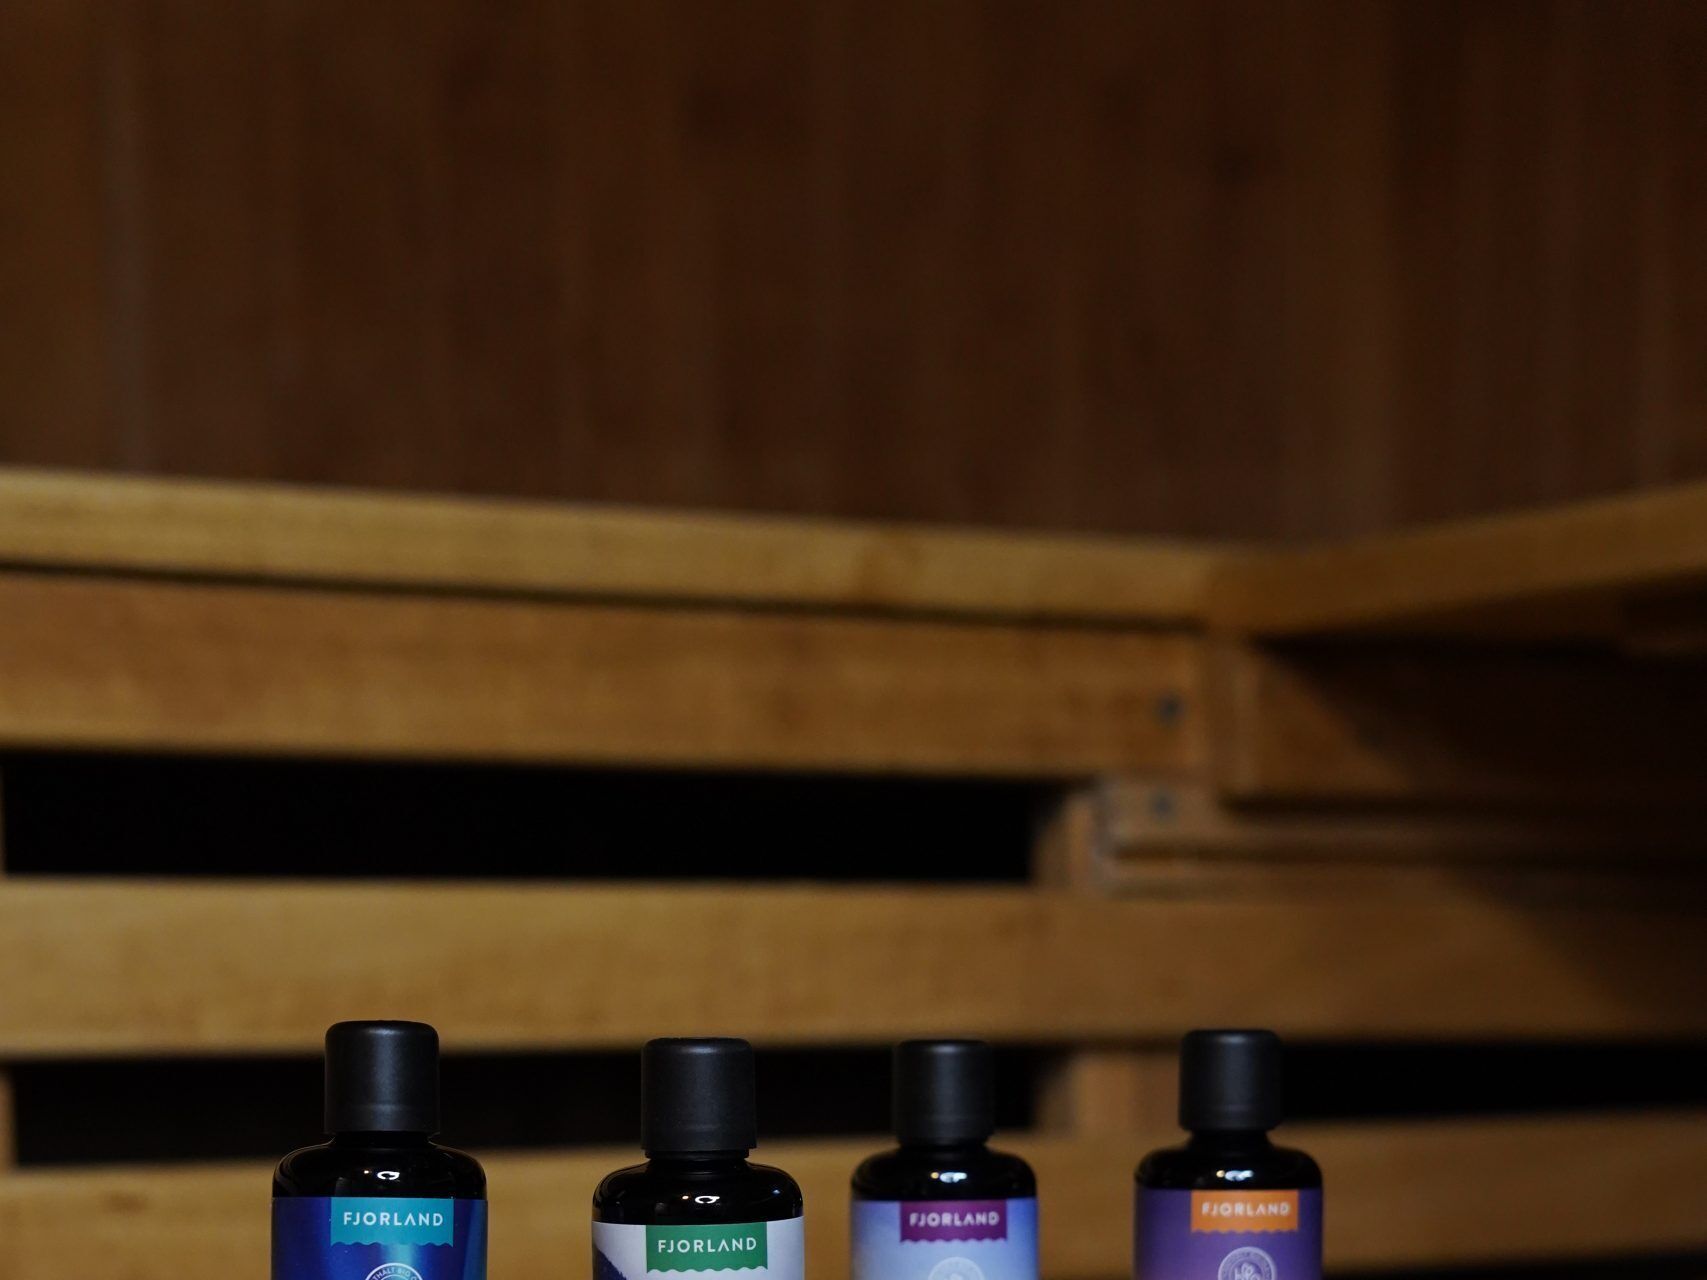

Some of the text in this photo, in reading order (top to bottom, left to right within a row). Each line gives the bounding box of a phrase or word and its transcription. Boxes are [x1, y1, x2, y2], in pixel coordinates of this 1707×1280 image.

[1201, 1202, 1291, 1217] FJORLAND
[343, 1211, 444, 1227] FJORLAND
[909, 1211, 1000, 1227] FJORLAND
[657, 1237, 758, 1254] FJORLAND
